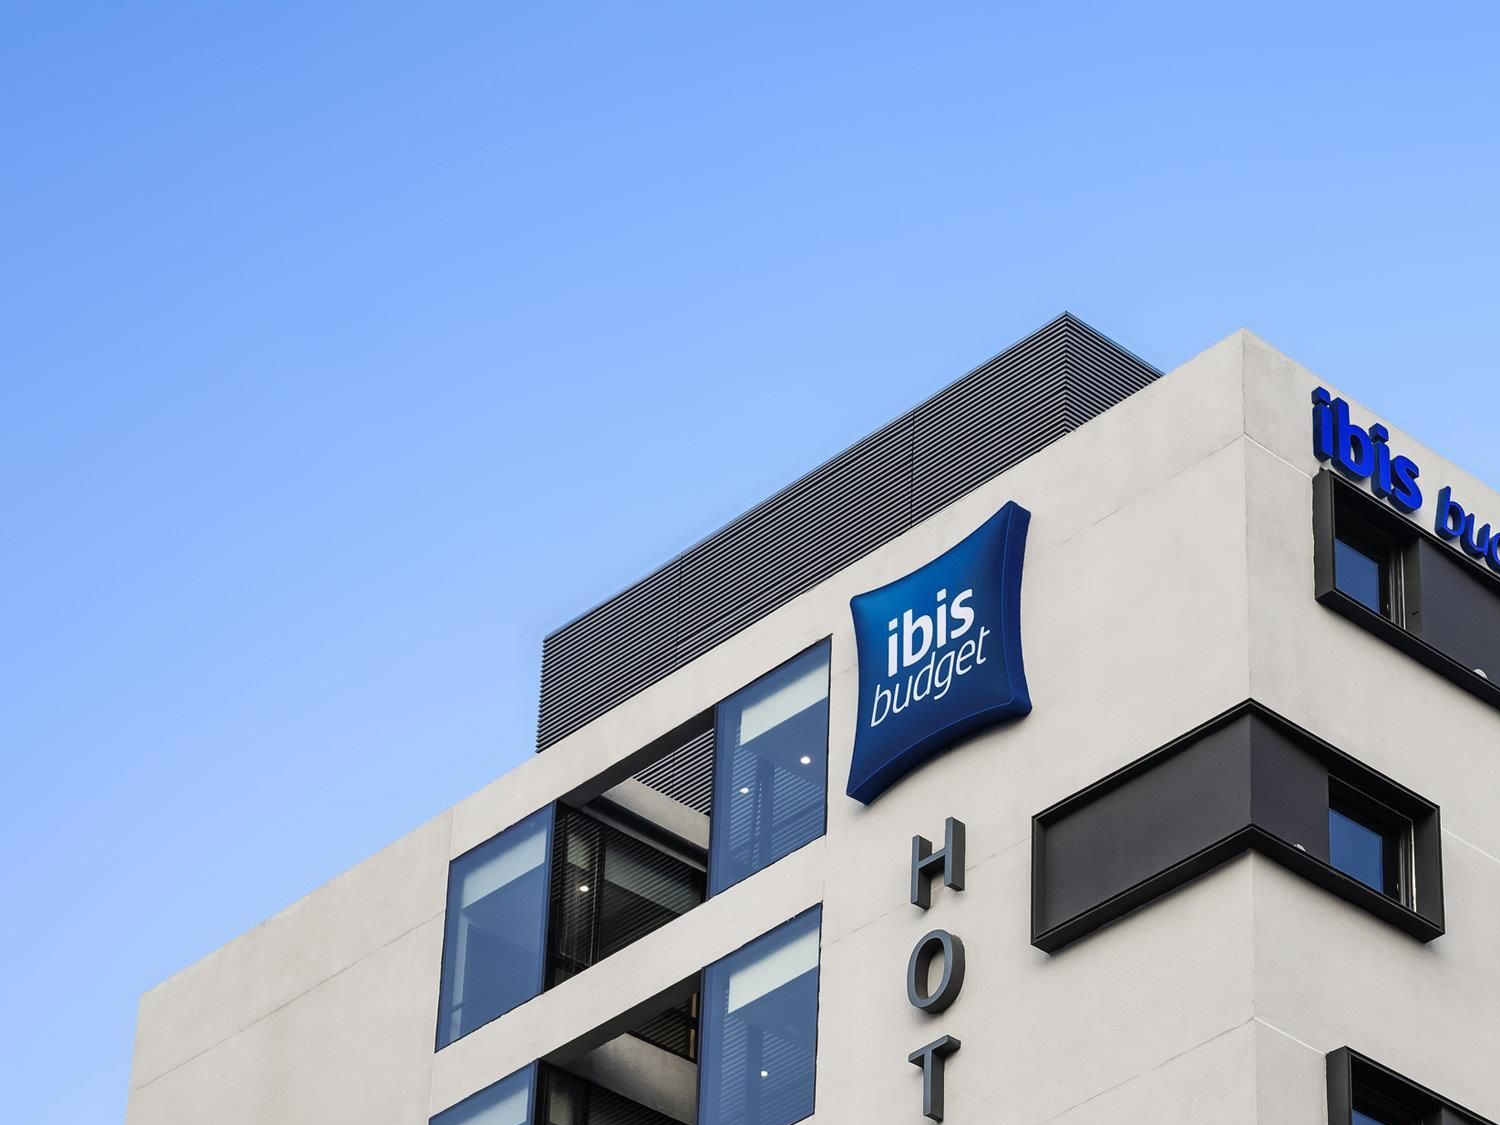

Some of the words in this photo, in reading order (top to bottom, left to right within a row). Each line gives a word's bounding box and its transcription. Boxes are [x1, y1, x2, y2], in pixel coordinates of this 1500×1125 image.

[1311, 386, 1423, 514] ibis
[870, 626, 990, 727] budget
[888, 588, 975, 677] ibis
